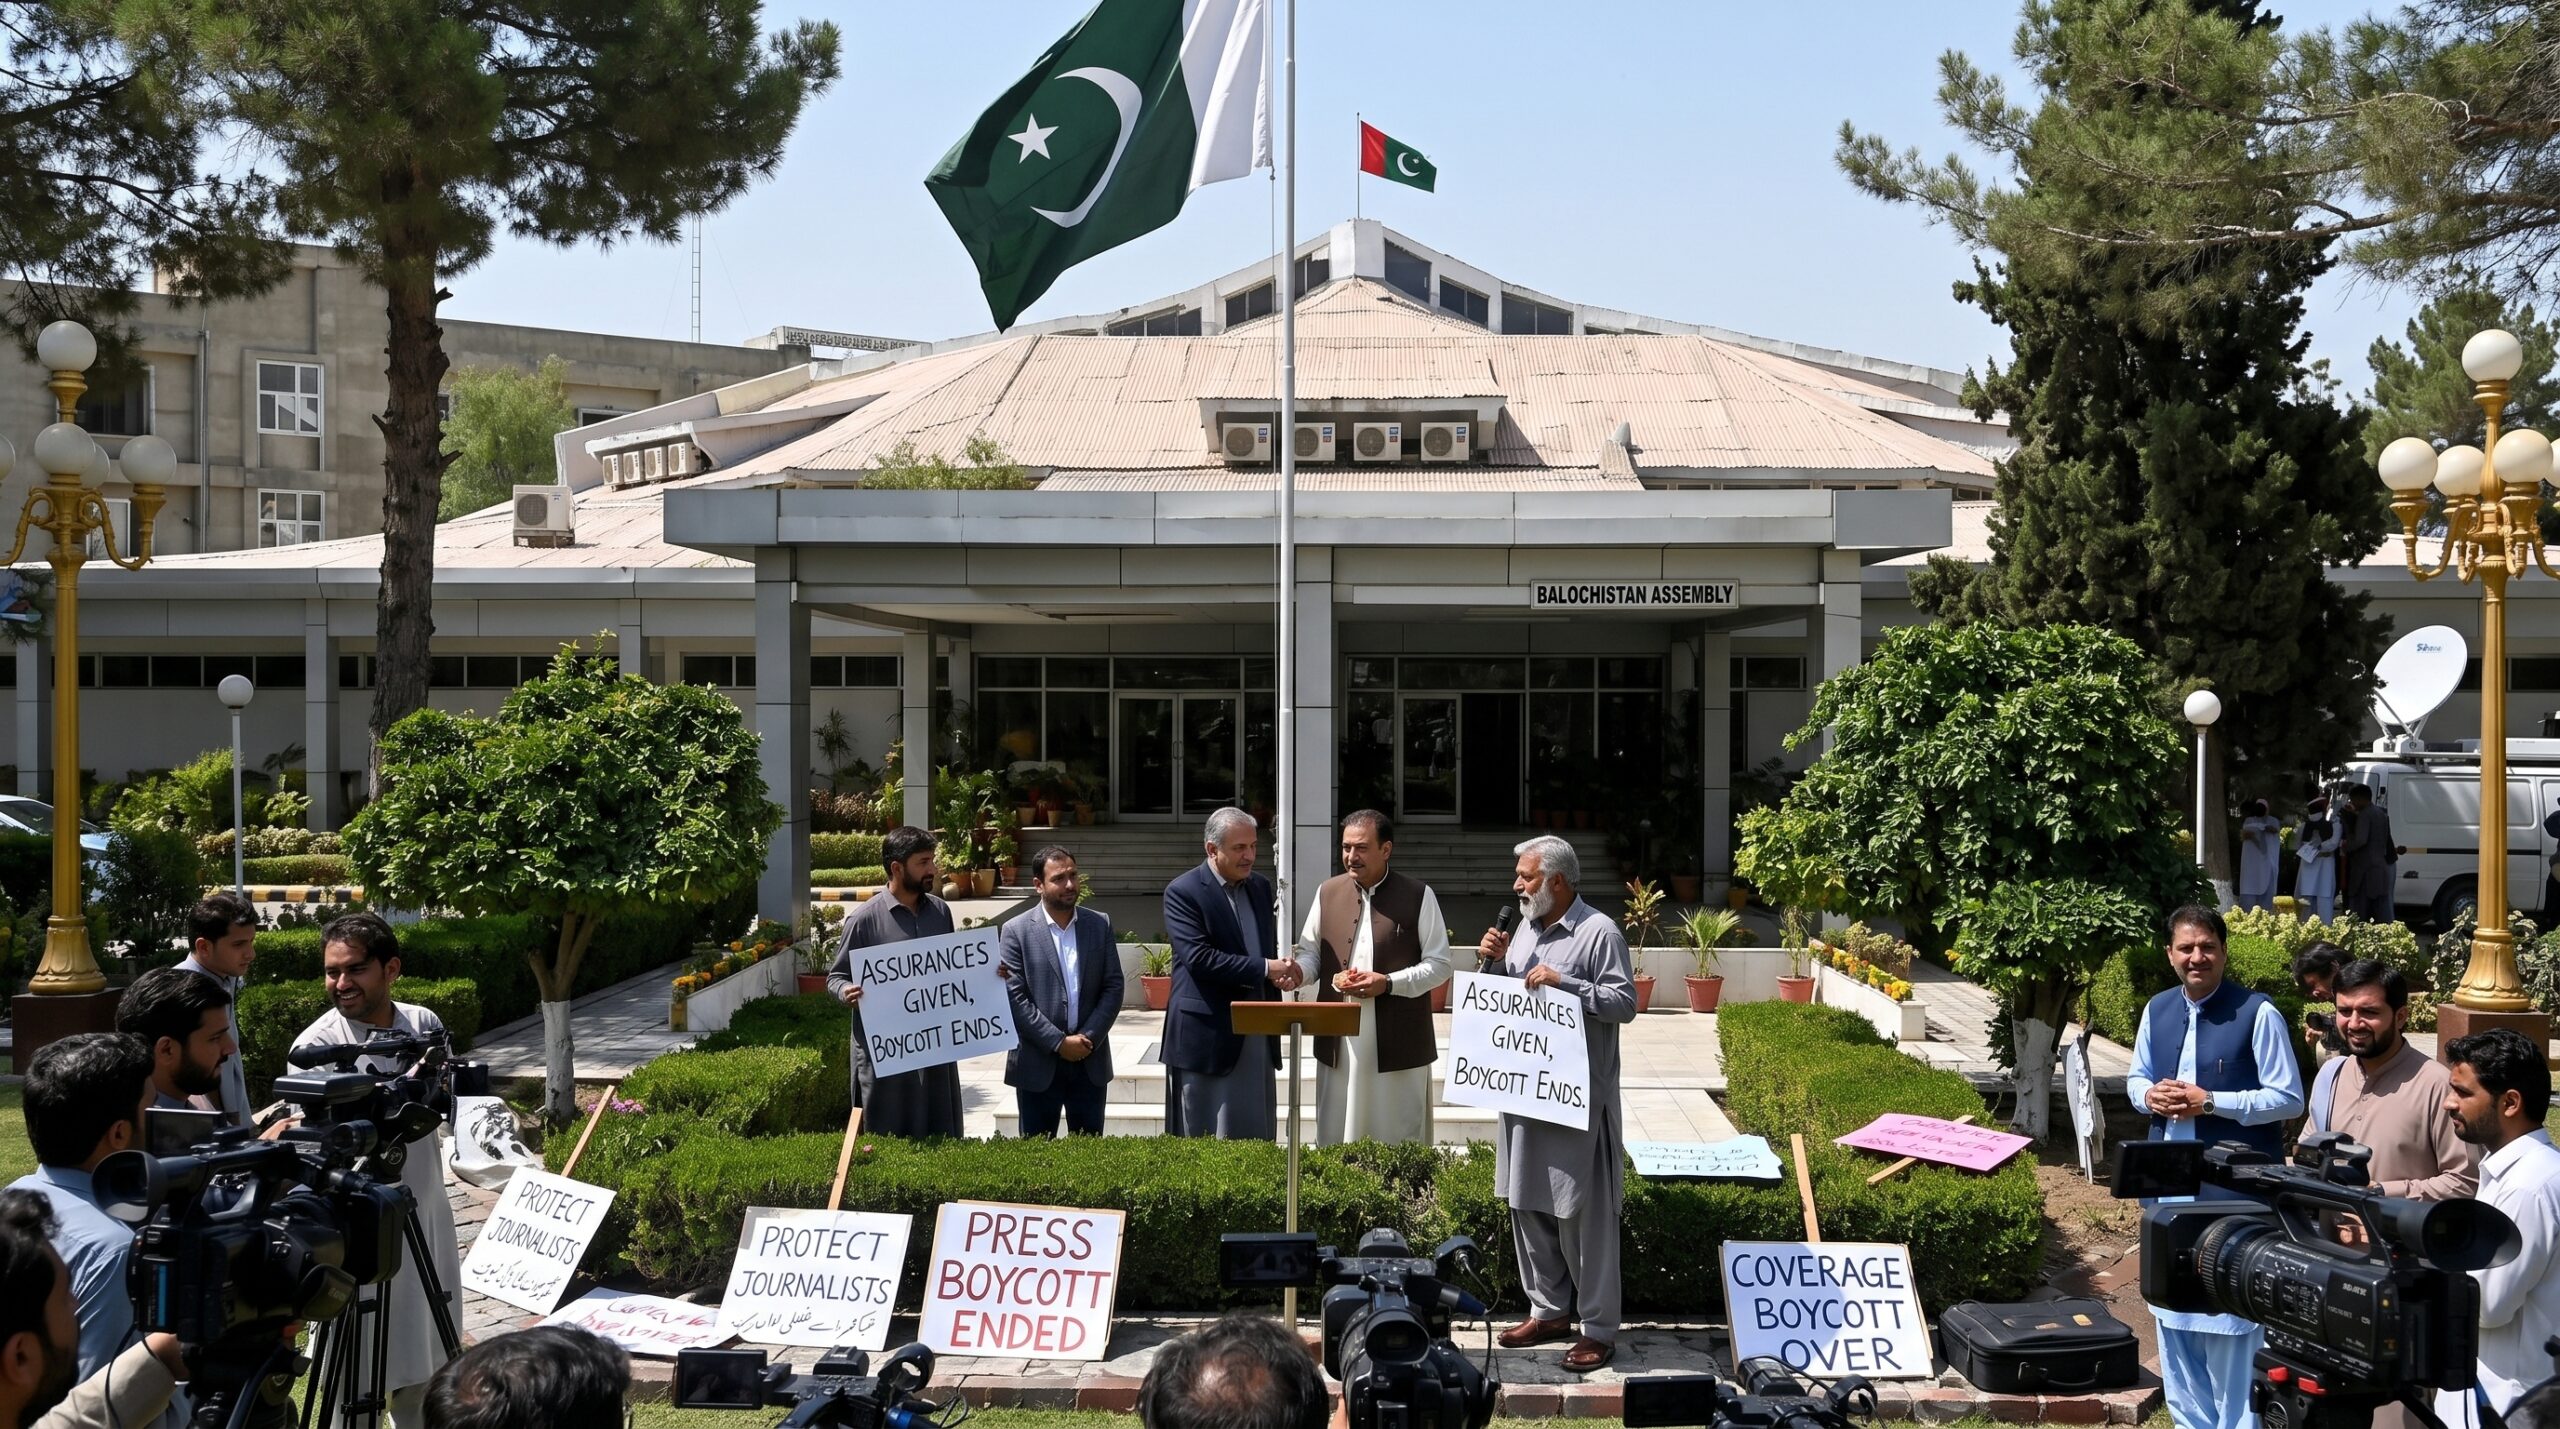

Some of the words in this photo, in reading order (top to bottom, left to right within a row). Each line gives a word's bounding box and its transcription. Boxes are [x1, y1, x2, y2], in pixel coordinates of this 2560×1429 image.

[1537, 585, 1647, 604] BALOCHISTAN
[1651, 585, 1733, 604] ASSEMBLY
[861, 941, 989, 988] ASSURANCES
[904, 980, 975, 1014] GIVEN,
[1462, 981, 1576, 1029] ASSURANCES
[951, 1016, 1009, 1046] ENDS.
[1492, 1025, 1553, 1062] GIVEN,
[514, 1181, 595, 1226] PROTECT
[488, 1216, 581, 1265] JOURNALISTS
[760, 1226, 889, 1262] PROTECT
[965, 1211, 1094, 1261] PRESS
[734, 1270, 892, 1305] JOURNALISTS
[937, 1259, 1112, 1309] BOYCOTT
[1731, 1253, 1904, 1289] COVERAGE
[950, 1310, 1086, 1353] ENDED
[1754, 1297, 1904, 1330] BOYCOTT
[1781, 1337, 1902, 1373] OVER
